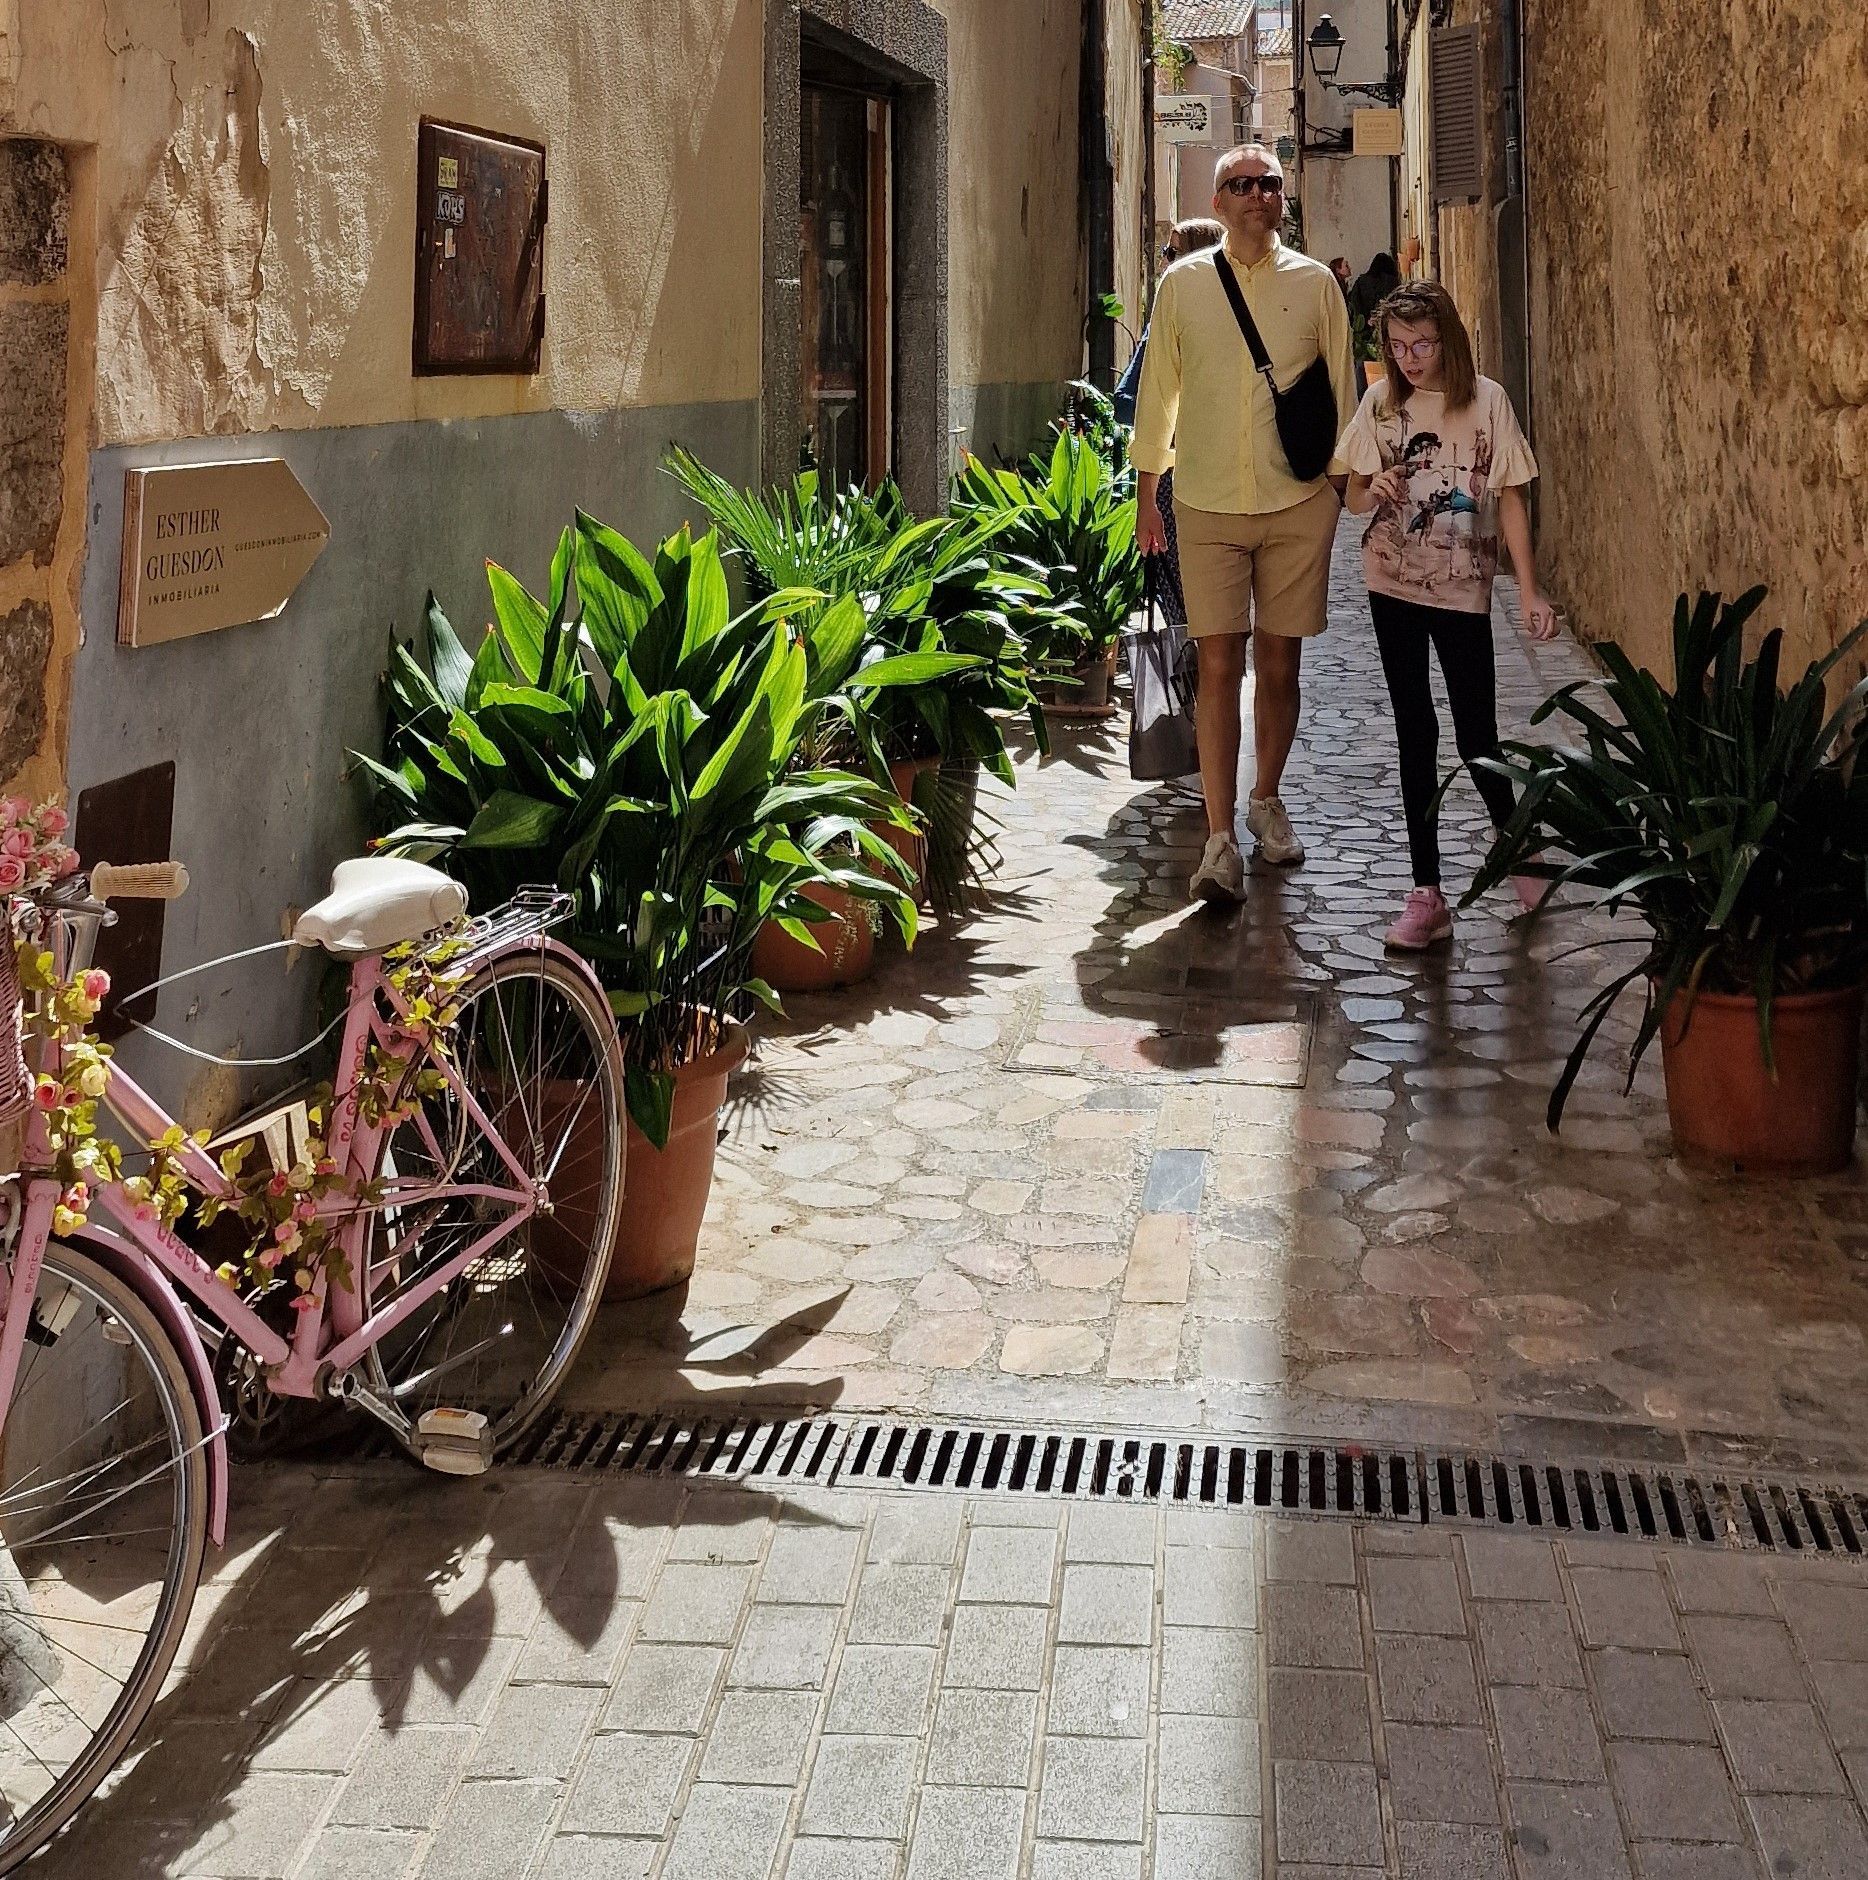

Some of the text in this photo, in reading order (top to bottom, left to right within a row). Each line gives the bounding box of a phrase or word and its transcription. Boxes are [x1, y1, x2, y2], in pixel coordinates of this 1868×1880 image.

[156, 508, 220, 540] ESTHER
[146, 545, 225, 581] GUESDON
[148, 583, 220, 606] INMOBILIARIA
